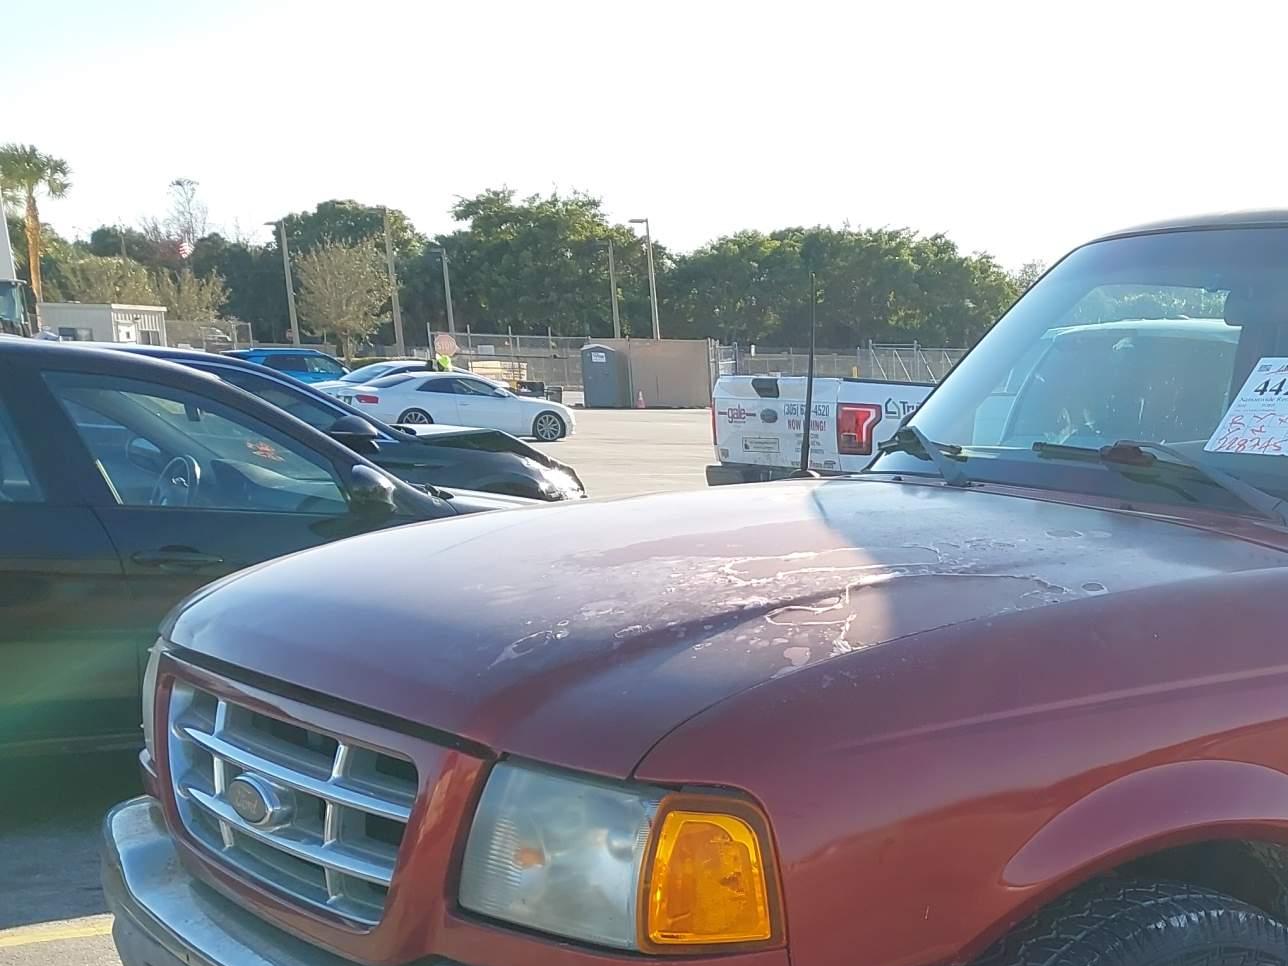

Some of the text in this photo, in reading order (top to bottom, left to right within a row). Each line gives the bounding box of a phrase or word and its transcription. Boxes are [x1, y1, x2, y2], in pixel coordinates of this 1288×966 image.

[727, 404, 746, 424] gale
[800, 403, 830, 417] 6-4520
[787, 419, 801, 431] NOW
